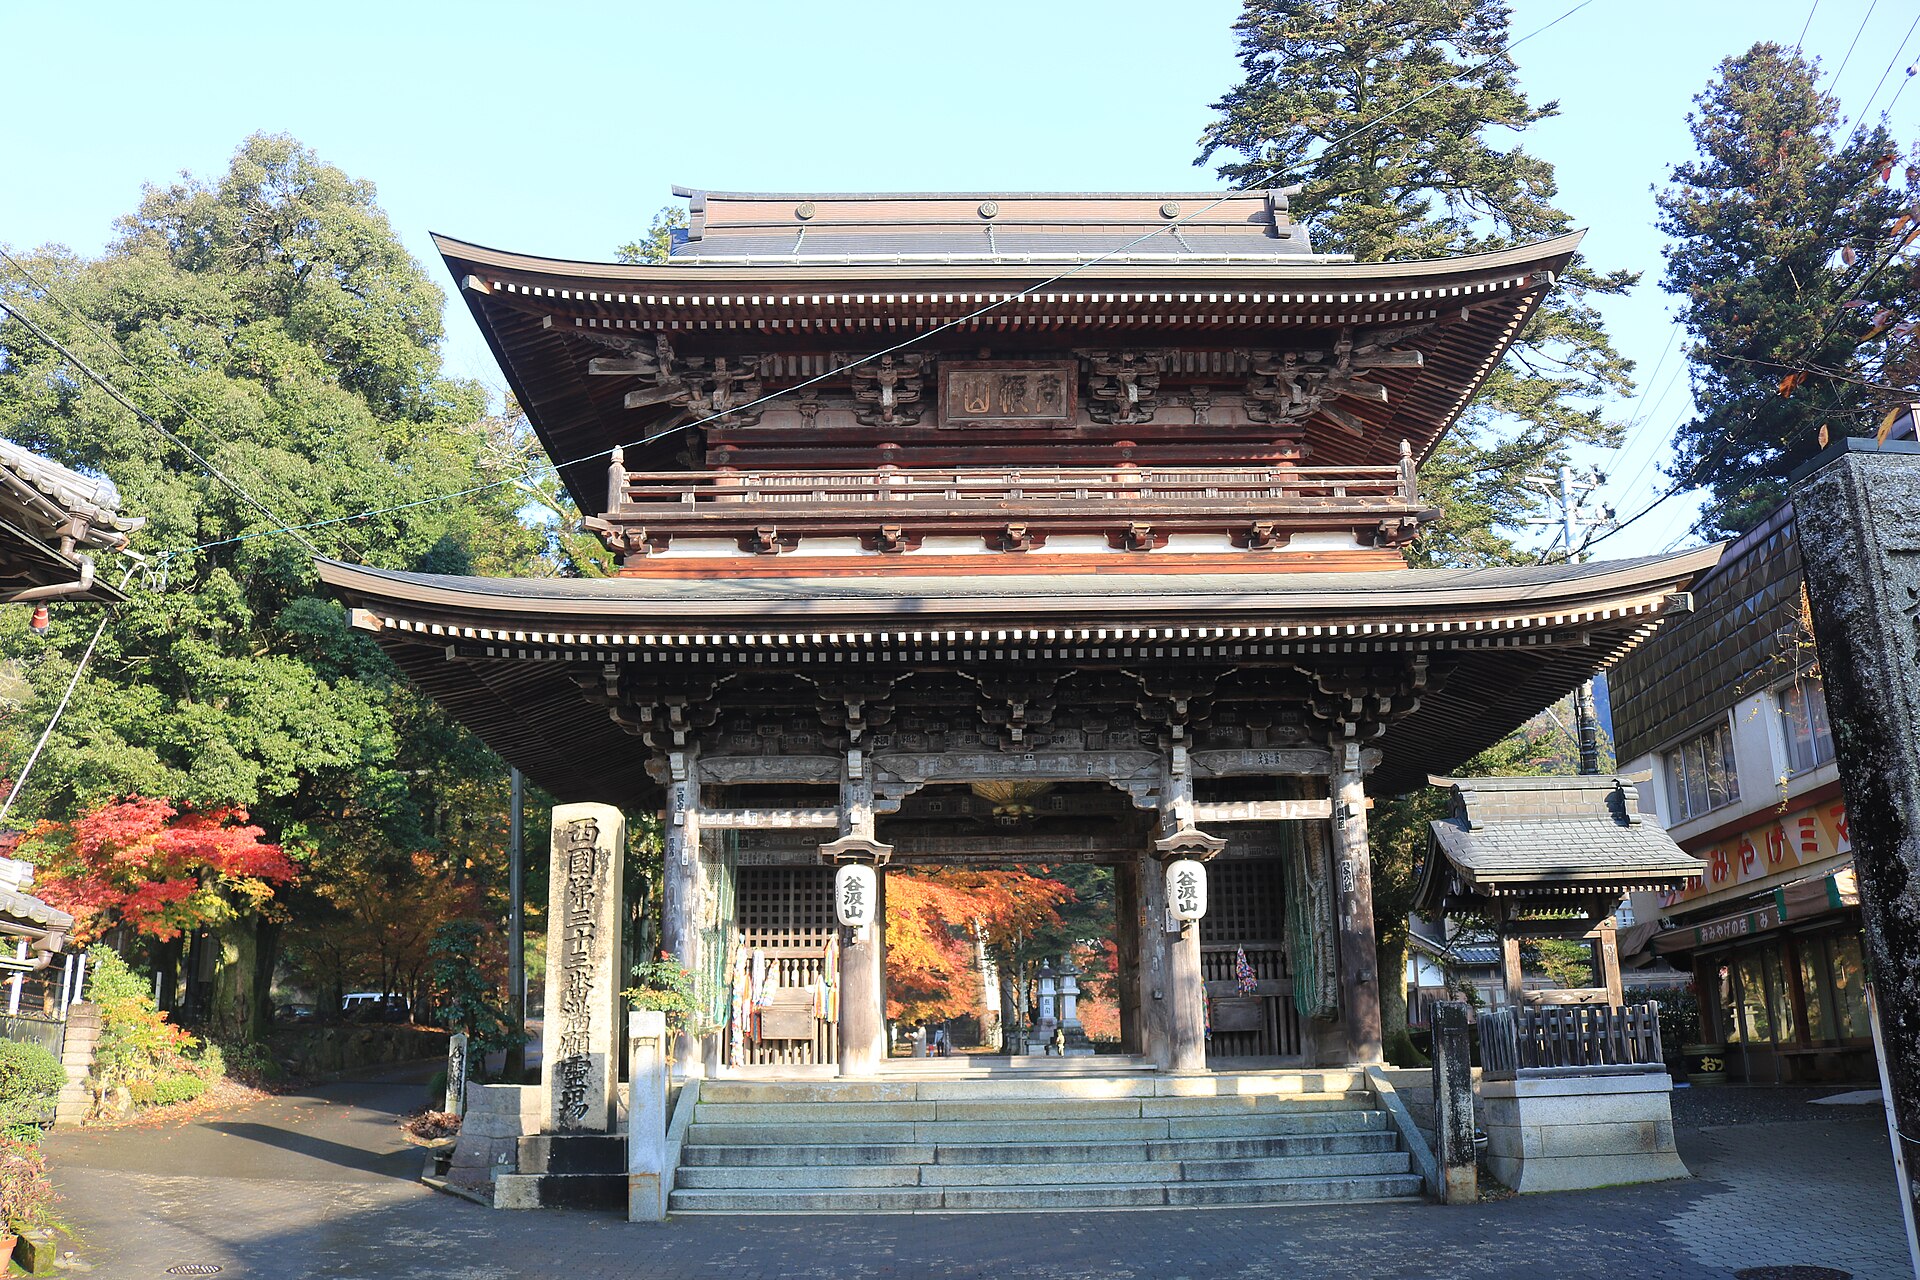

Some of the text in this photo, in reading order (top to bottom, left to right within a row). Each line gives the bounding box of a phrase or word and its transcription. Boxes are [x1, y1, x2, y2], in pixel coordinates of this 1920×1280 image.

[843, 875, 865, 919] 谷汲山
[1176, 870, 1199, 912] 谷汲山
[1701, 917, 1747, 942] おみやげの店
